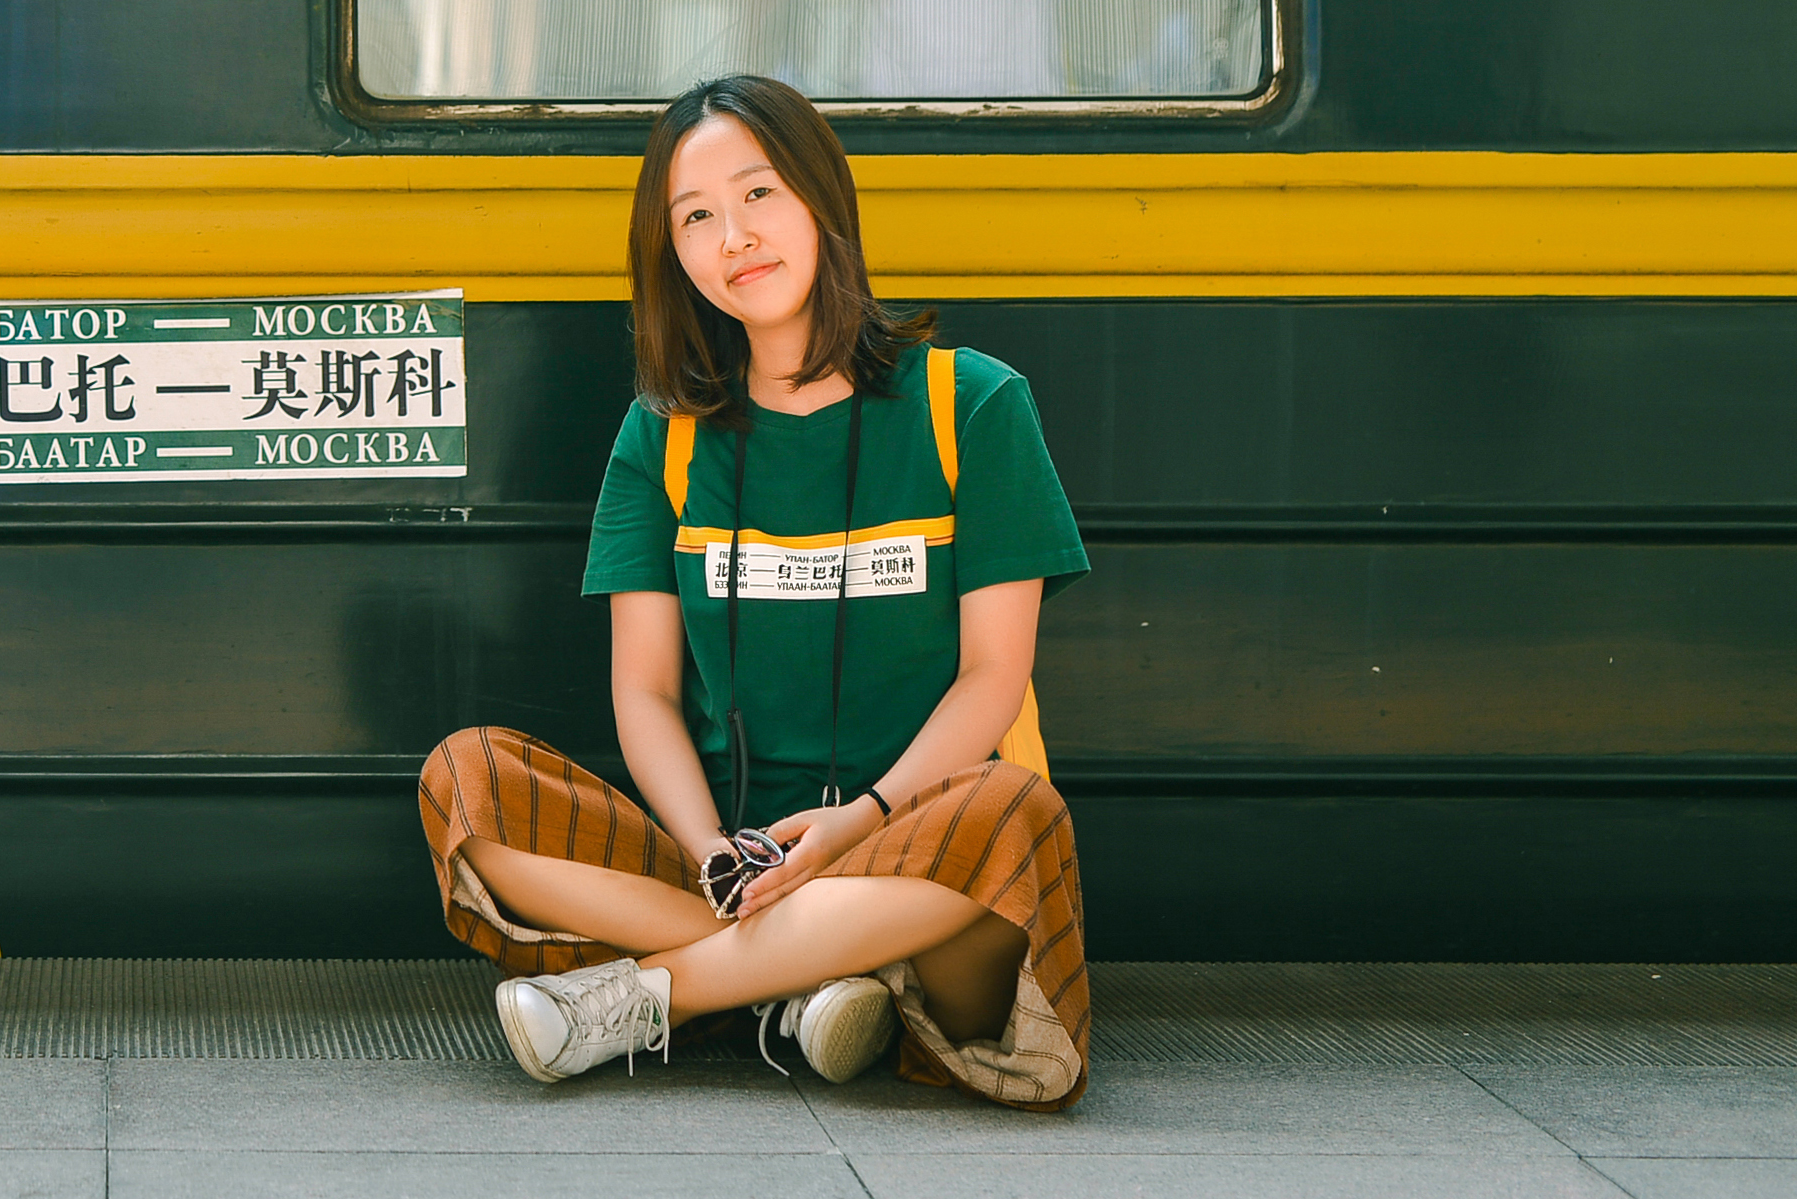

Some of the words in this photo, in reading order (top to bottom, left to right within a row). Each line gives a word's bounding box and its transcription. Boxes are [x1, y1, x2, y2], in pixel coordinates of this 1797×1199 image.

[252, 303, 437, 336] МОСКВА
[241, 347, 456, 421] 莫斯科
[255, 431, 440, 466] МОСКВА
[719, 551, 747, 559] ПЕИН
[873, 545, 911, 556] МОСКВА
[715, 562, 748, 578] 北京
[871, 557, 916, 576] 莫斯科
[714, 580, 748, 590] БЭЭИН
[874, 576, 913, 587] МОСКВА
